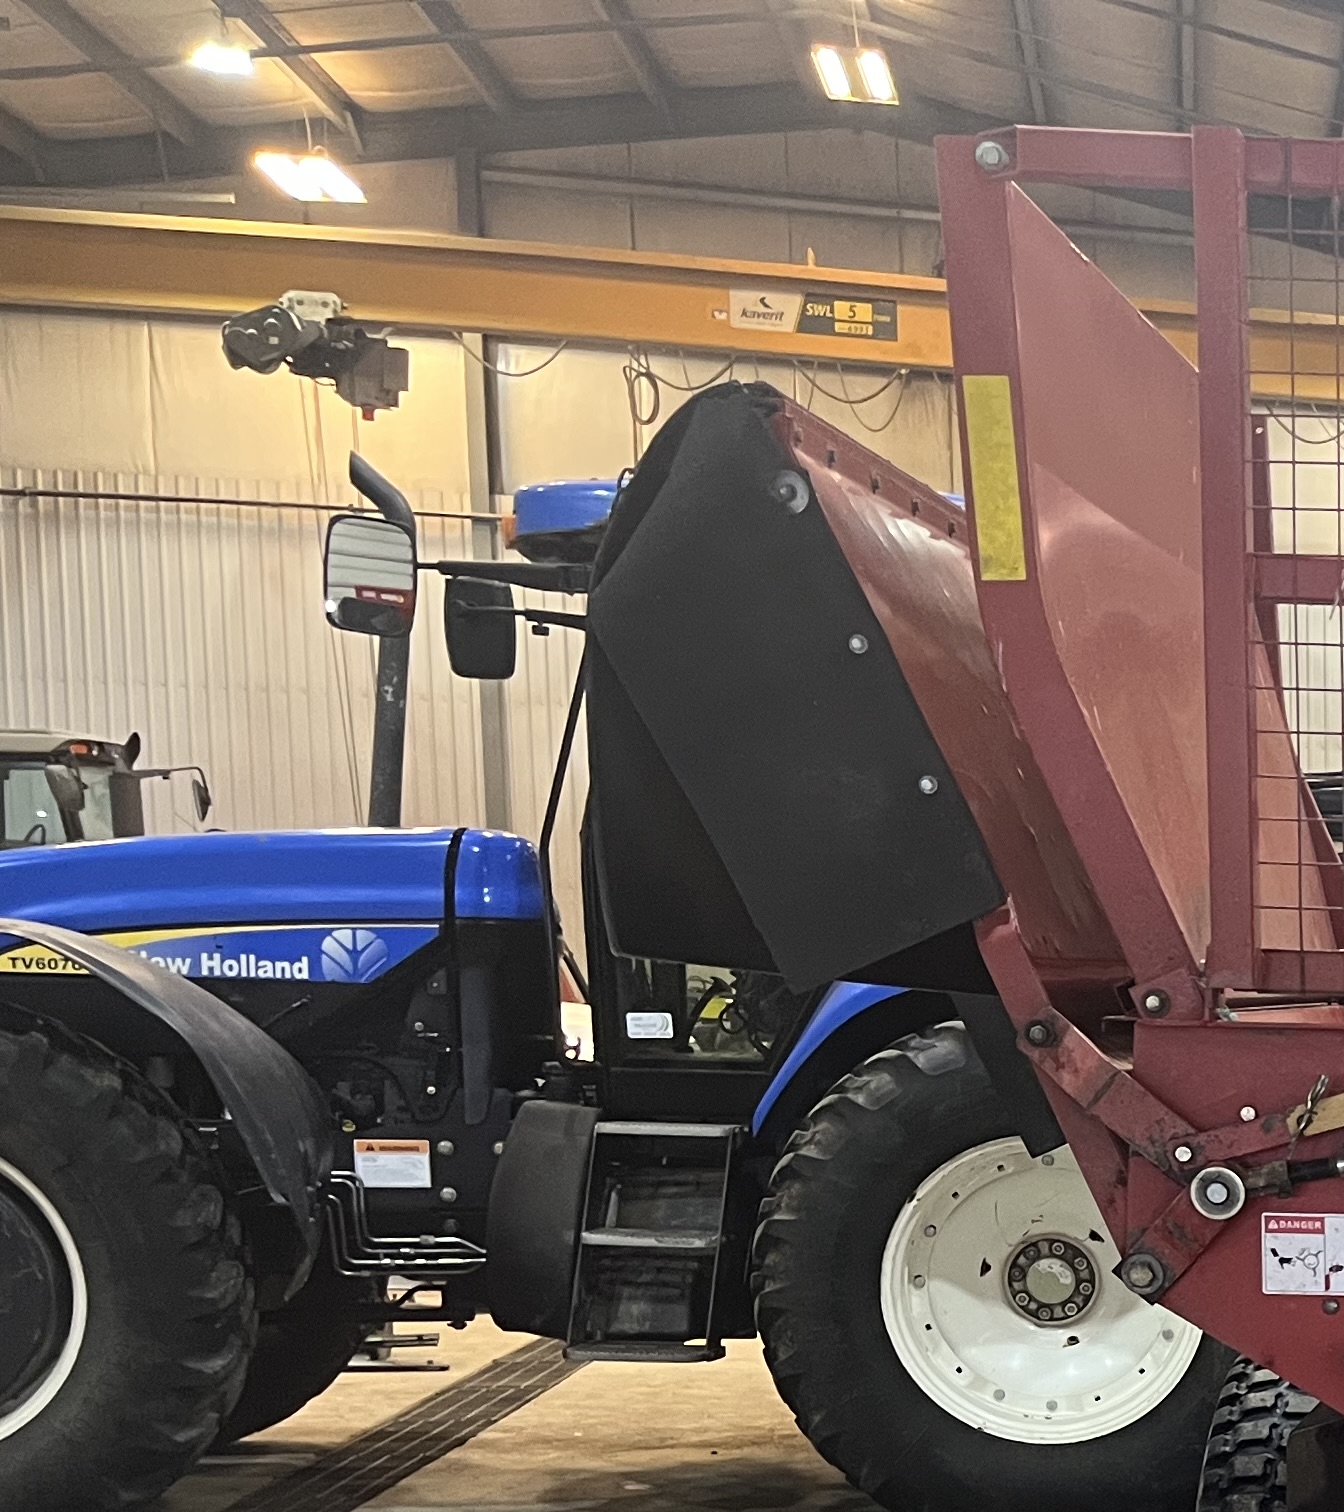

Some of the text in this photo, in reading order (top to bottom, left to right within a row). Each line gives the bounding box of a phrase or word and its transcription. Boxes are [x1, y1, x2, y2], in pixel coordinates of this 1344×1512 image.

[805, 303, 833, 317] SWL
[848, 304, 857, 319] 5
[200, 952, 309, 980] Holland
[1279, 1220, 1322, 1229] DANGER
